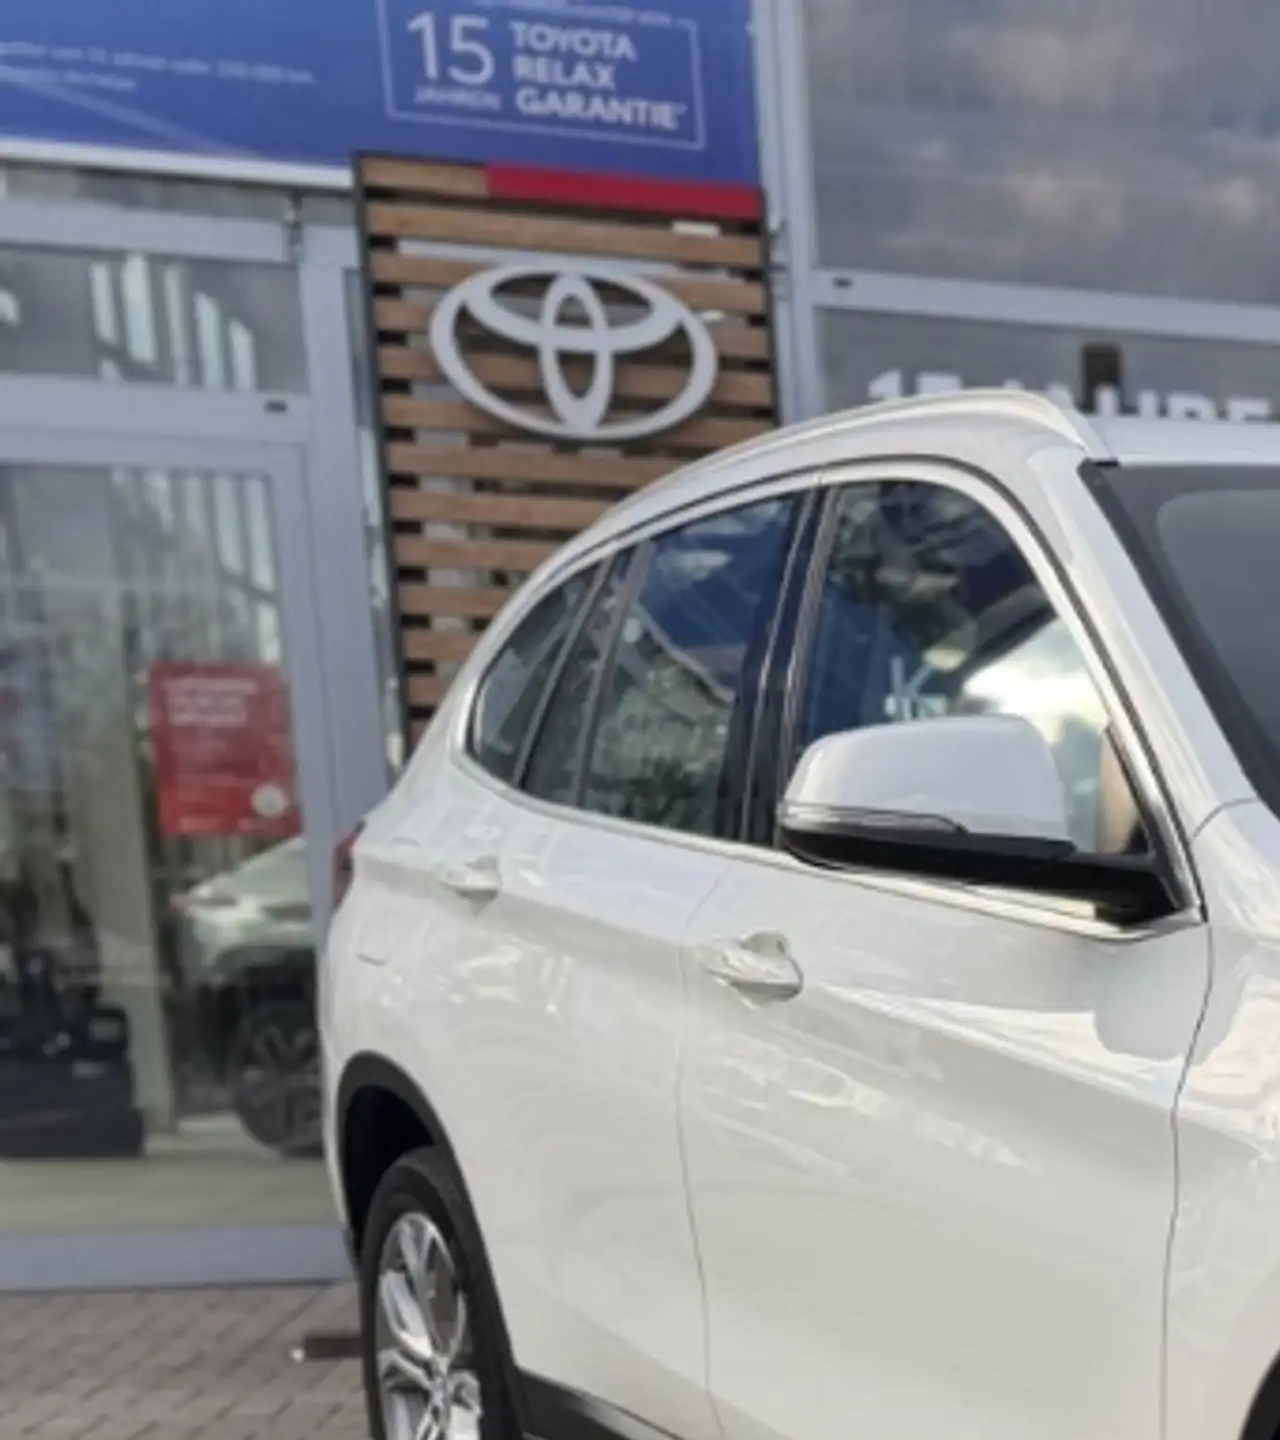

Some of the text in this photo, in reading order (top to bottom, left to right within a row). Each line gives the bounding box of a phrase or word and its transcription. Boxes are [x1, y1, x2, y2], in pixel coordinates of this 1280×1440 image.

[407, 12, 495, 85] 15
[508, 20, 638, 62] TOYOTA
[511, 55, 615, 90] RELAX
